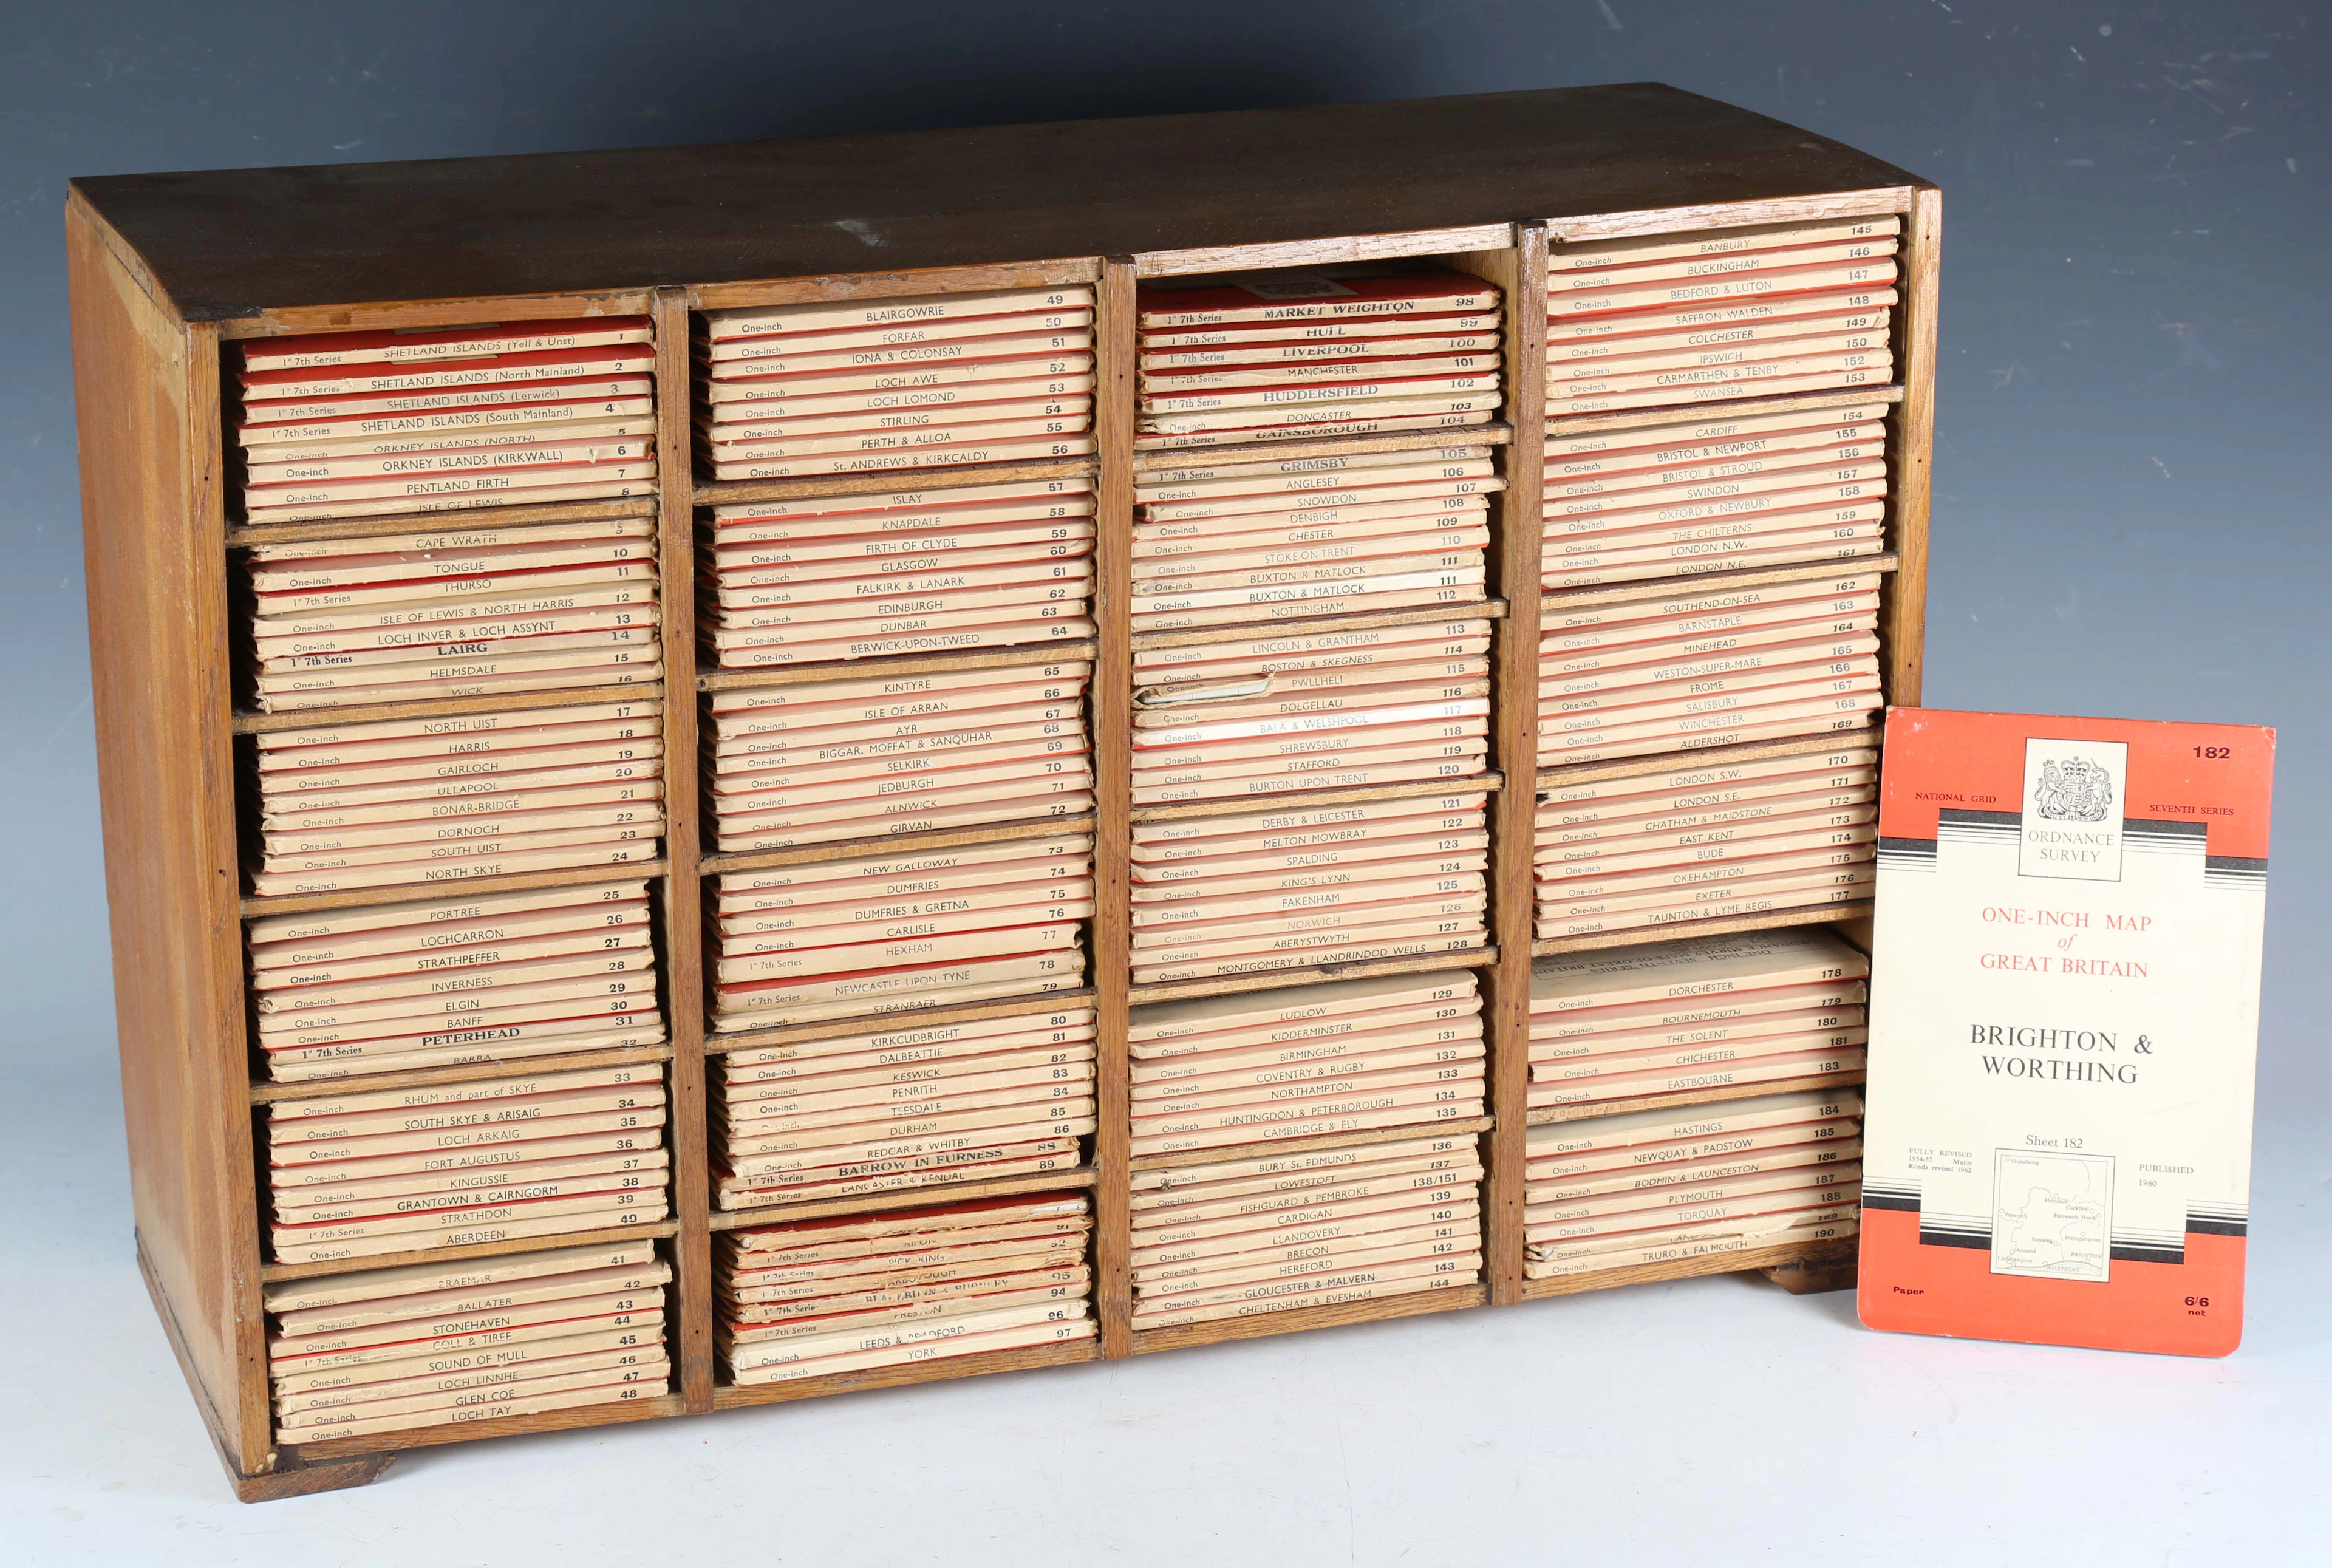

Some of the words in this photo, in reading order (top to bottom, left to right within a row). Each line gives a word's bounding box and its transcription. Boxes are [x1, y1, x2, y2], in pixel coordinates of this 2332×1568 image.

[1575, 299, 1611, 310] One-inch
[1671, 284, 1718, 299] BEDFORD
[1724, 285, 1730, 294] &
[1736, 281, 1771, 293] LUTON
[1849, 270, 1868, 280] 147
[1181, 315, 1194, 324] 7th
[1198, 313, 1221, 322] Series
[1265, 307, 1325, 318] MARKET
[1333, 302, 1414, 313] WEIGHTON
[286, 467, 329, 477] One-inch
[383, 459, 432, 471] ORKNEY
[440, 455, 488, 467] ISLANDS
[494, 451, 562, 466] (KIRKWALL)
[618, 446, 626, 455] 6
[750, 467, 789, 477] One-inch
[834, 462, 847, 471] St.
[850, 457, 906, 469] ANDREWS
[927, 451, 988, 464] KIRKCALDY
[1052, 445, 1068, 454] 56
[1563, 462, 1600, 473] One-inch
[1657, 446, 1698, 462] BRISTOL
[1716, 440, 1766, 455] NEWPORT
[1836, 428, 1856, 438] 155
[1158, 490, 1196, 499] One-inch
[1286, 477, 1339, 489] ANGLESEY
[1443, 468, 1463, 477] 106
[752, 615, 790, 625] One-inch
[879, 601, 942, 614] EDINBURGH
[1050, 589, 1065, 598] 62
[305, 656, 322, 666] 7th
[325, 655, 352, 664] Series
[437, 643, 488, 656] LAIRG
[612, 631, 630, 640] 14
[754, 652, 793, 662] One-inch
[851, 633, 980, 654] BERWICK-UPON-TWEED
[1052, 627, 1068, 636] 64
[293, 680, 334, 689] One-inch
[431, 665, 496, 678] HELMSDALE
[615, 653, 628, 662] 15
[1564, 681, 1599, 692] One-inch
[1654, 657, 1762, 679] WESTON-SUPER-MARE
[1833, 646, 1852, 655] 165
[752, 777, 789, 788] One-inch
[887, 758, 931, 772] SELKIRK
[1048, 741, 1062, 751] 69
[2194, 746, 2230, 758] 182
[1161, 789, 1198, 799] One-inch
[1250, 780, 1294, 792] BURTON
[1299, 777, 1329, 787] UPON
[1334, 773, 1368, 784] TRENT
[1439, 765, 1459, 774] 120
[1561, 790, 1597, 800] One-inch
[1670, 772, 1715, 786] LONDON
[1720, 770, 1741, 780] S.W.
[1829, 756, 1848, 765] 170
[1915, 793, 1965, 801] NATIONAL
[2150, 805, 2195, 813] SEVENTH
[2029, 831, 2113, 845] ORDNANCE
[2040, 848, 2099, 862] SURVEY
[296, 882, 336, 891] One-inch
[426, 868, 467, 879] NORTH
[474, 865, 501, 875] SKYE
[613, 853, 628, 861] 24
[1982, 907, 2088, 927] ONE-INCH
[2106, 915, 2151, 931] MAP
[886, 943, 932, 956] HEXHAM
[1042, 930, 1056, 939] 77
[1159, 970, 1195, 980] One-inch
[1218, 959, 1293, 973] MONTGOMERY
[1311, 947, 1387, 963] LLANDRINDOD
[1393, 945, 1425, 954] WELLS
[1448, 940, 1467, 949] 128
[2058, 934, 2078, 951] of
[290, 973, 331, 984] One-inch
[418, 952, 500, 969] STRATHPEFFER
[605, 938, 620, 947] 27
[1981, 954, 2051, 972] GREAT
[2062, 958, 2147, 977] BRITAIN
[1559, 999, 1593, 1008] One-inch
[1669, 982, 1733, 996] DORCHESTER
[1822, 969, 1841, 978] 178
[759, 1050, 797, 1060] One-inch
[872, 1029, 960, 1047] KIRKCUDBRIGHT
[1051, 1016, 1066, 1025] 80
[1161, 1067, 1196, 1077] One-inch
[1280, 1046, 1346, 1062] BIRMINGHAM
[1438, 1031, 1454, 1040] 131
[1971, 1025, 2118, 1051] BRIGHTON
[2134, 1035, 2152, 1054] &
[1555, 1092, 1590, 1103] One-inch
[1668, 1074, 1733, 1089] EASTBOURNE
[1819, 1062, 1839, 1071] 183
[1982, 1056, 2138, 1083] WORTHING
[2026, 1135, 2058, 1147] Sheet
[2065, 1138, 2082, 1148] 182
[2139, 1164, 2194, 1174] PUBLISHED
[313, 1210, 353, 1220] One-inch
[397, 1196, 468, 1211] GRANTOWN
[488, 1186, 557, 1201] CAIRNGORM
[623, 1178, 638, 1187] 38
[1555, 1209, 1589, 1219] One-inch
[1669, 1190, 1722, 1204] PLYMOUTH
[1816, 1174, 1834, 1184] 187
[1162, 1281, 1198, 1292] One-inch
[1280, 1260, 1332, 1275] HEREFORD
[1433, 1243, 1452, 1253] 142
[2185, 1297, 2209, 1307] 6/6
[771, 1368, 808, 1380] One-inch
[908, 1348, 937, 1360] YORK
[1057, 1328, 1071, 1338] 97
[312, 1429, 352, 1440] One-inch
[452, 1409, 483, 1421] LOCH
[489, 1406, 511, 1416] TAY
[621, 1390, 636, 1399] 48
